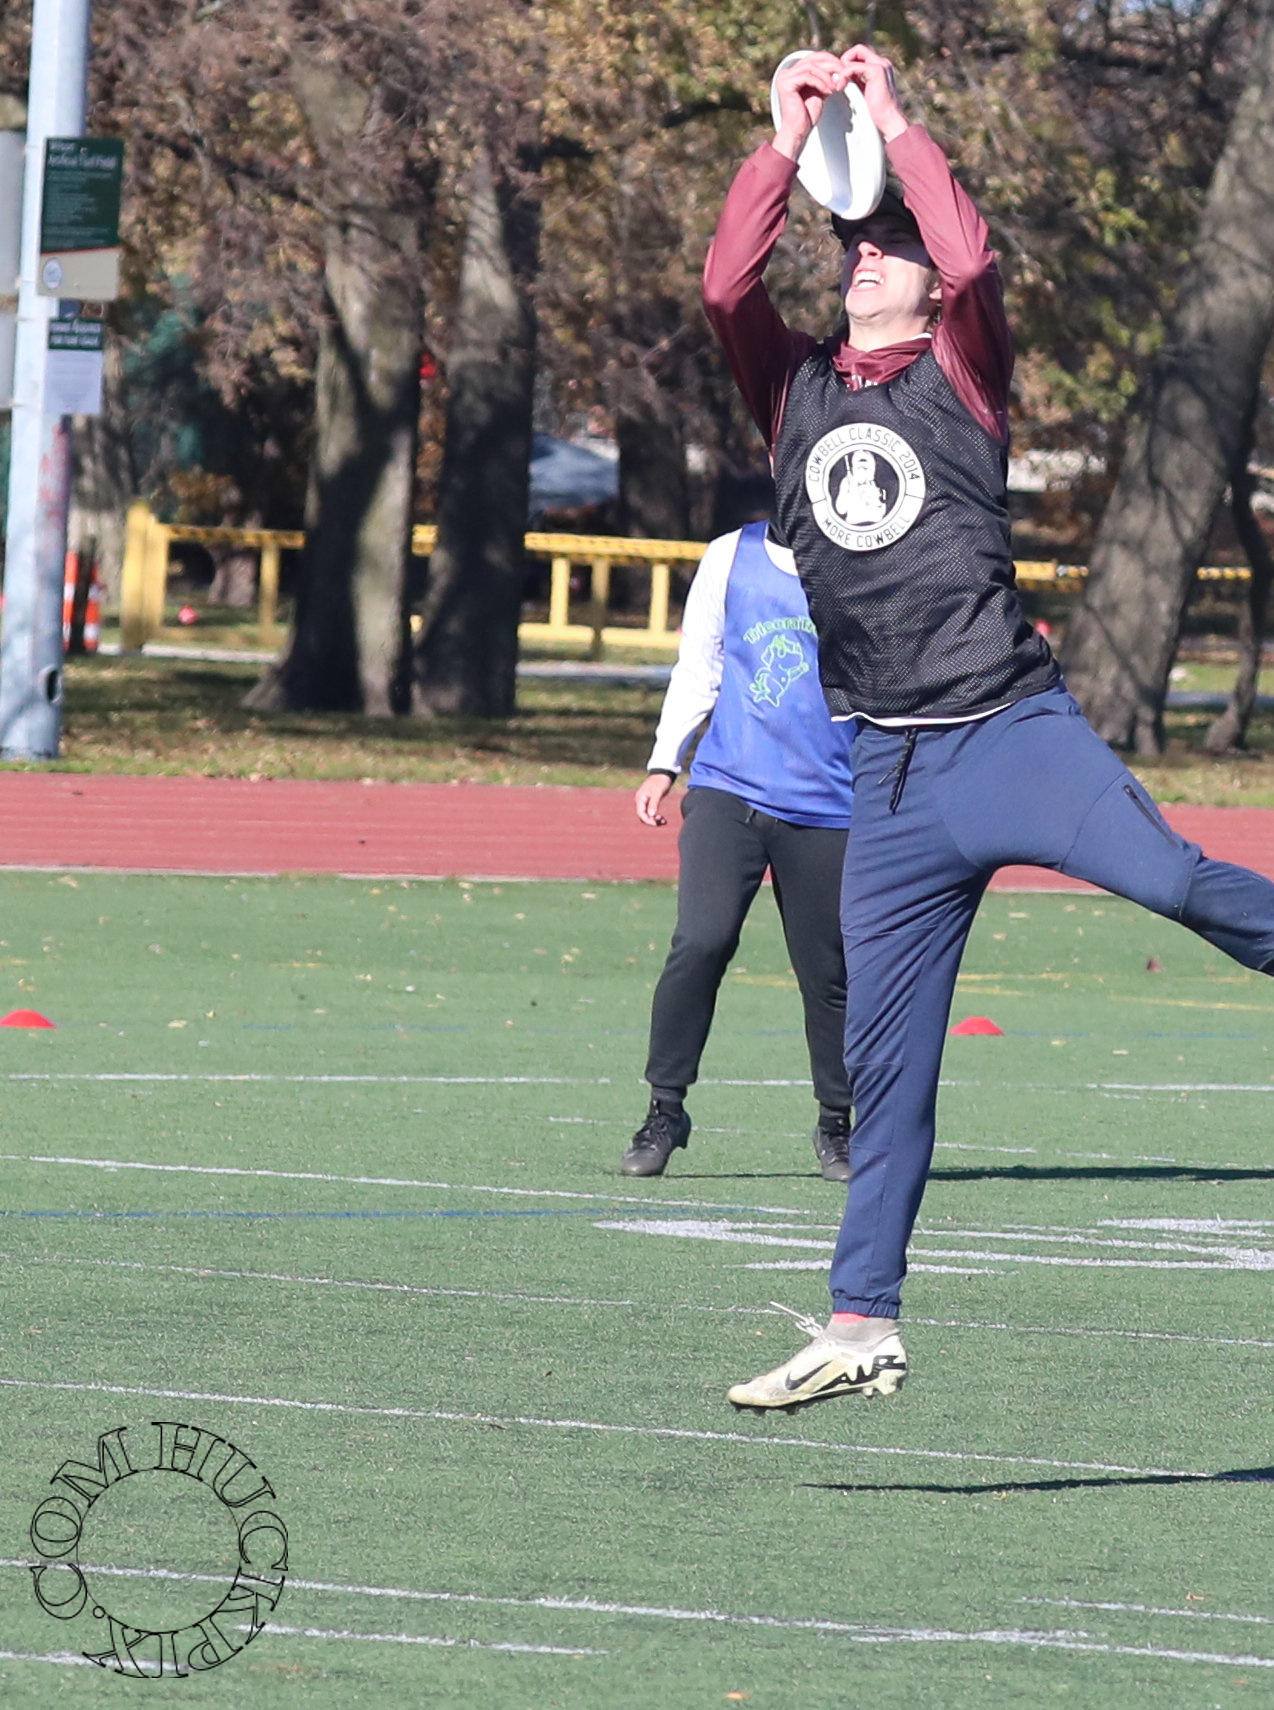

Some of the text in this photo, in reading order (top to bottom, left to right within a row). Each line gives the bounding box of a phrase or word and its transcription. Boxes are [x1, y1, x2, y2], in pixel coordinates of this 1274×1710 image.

[808, 427, 921, 483] COWBELL CLASSIC 2014
[823, 516, 910, 548] MORE COWBELL
